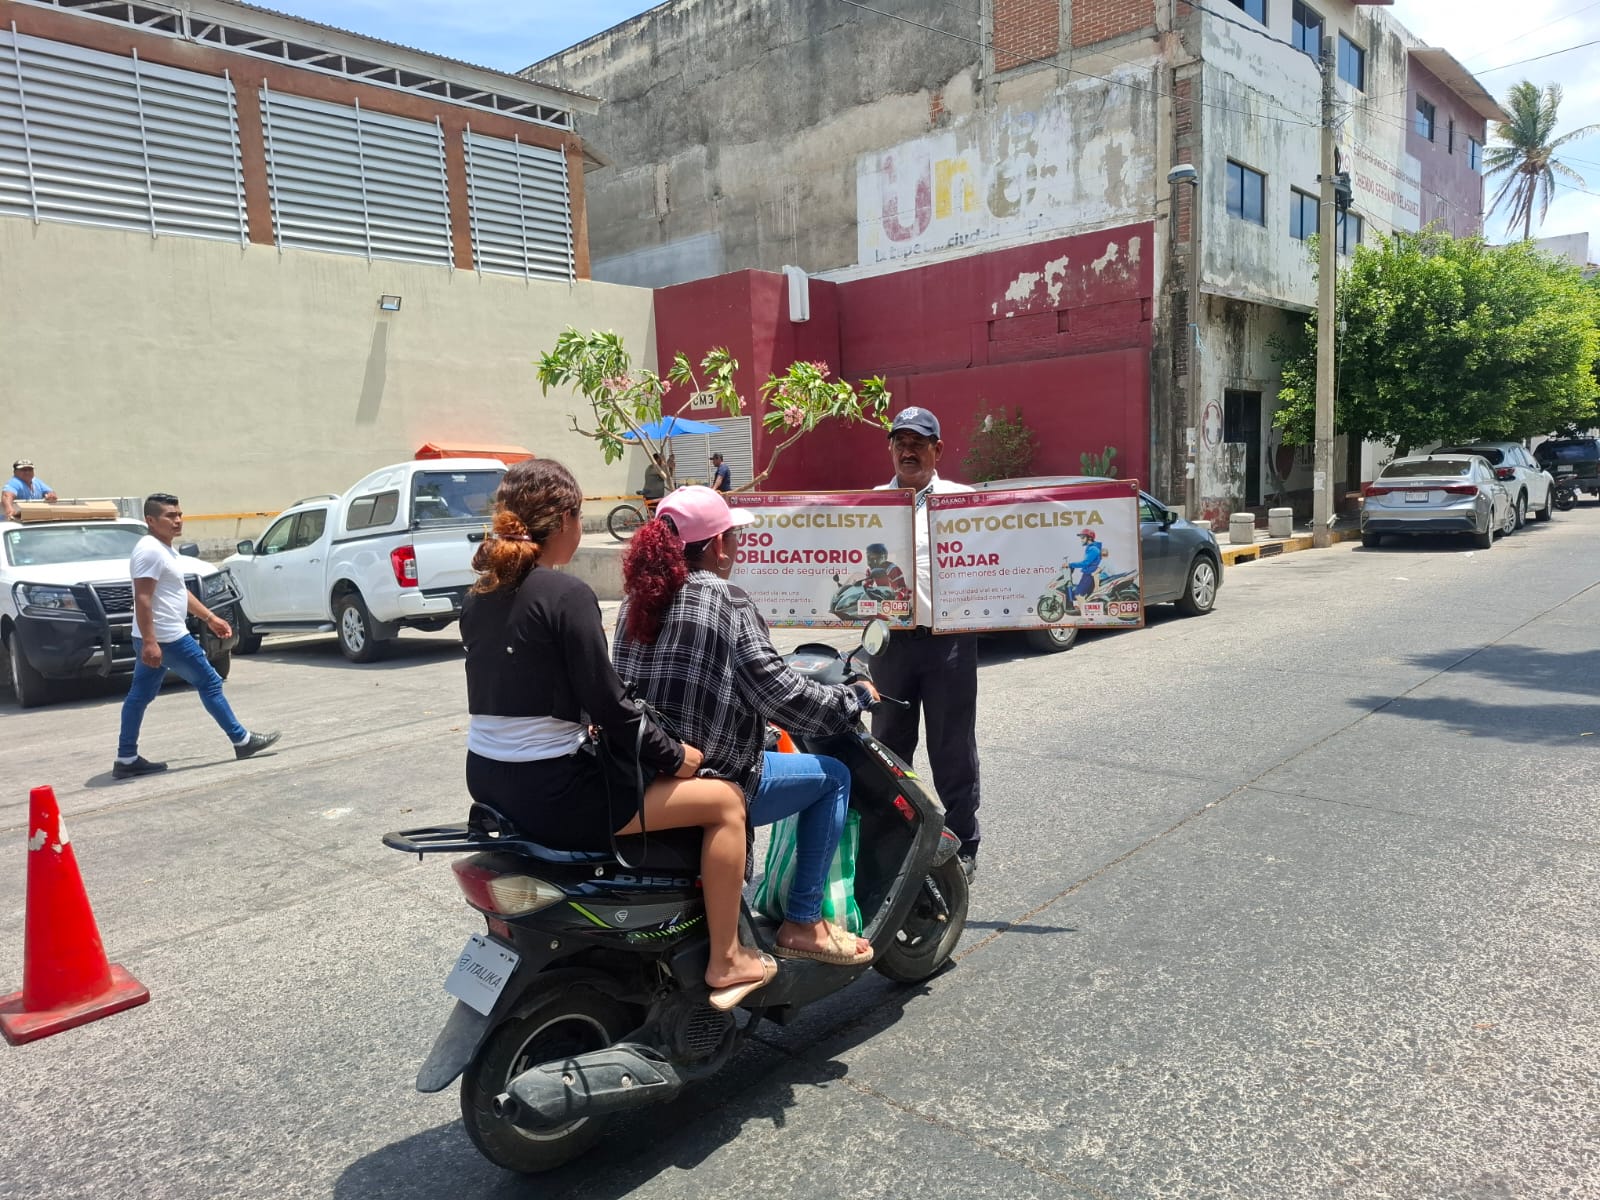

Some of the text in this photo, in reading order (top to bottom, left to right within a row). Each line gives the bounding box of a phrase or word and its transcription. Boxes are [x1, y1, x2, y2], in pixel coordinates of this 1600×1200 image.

[742, 513, 883, 529] OTOCICLISTA
[936, 510, 1104, 535] MOTOCICLISTA
[736, 532, 773, 547] USO
[936, 540, 963, 555] NO
[735, 549, 863, 564] OBLIGATORIO
[937, 553, 1000, 569] VIAJAR
[734, 567, 749, 575] del
[782, 567, 795, 575] de
[938, 564, 1057, 580] Con menores de diez años.
[892, 602, 908, 610] 089
[1120, 602, 1138, 613] 089
[466, 961, 503, 988] ITALIKA
